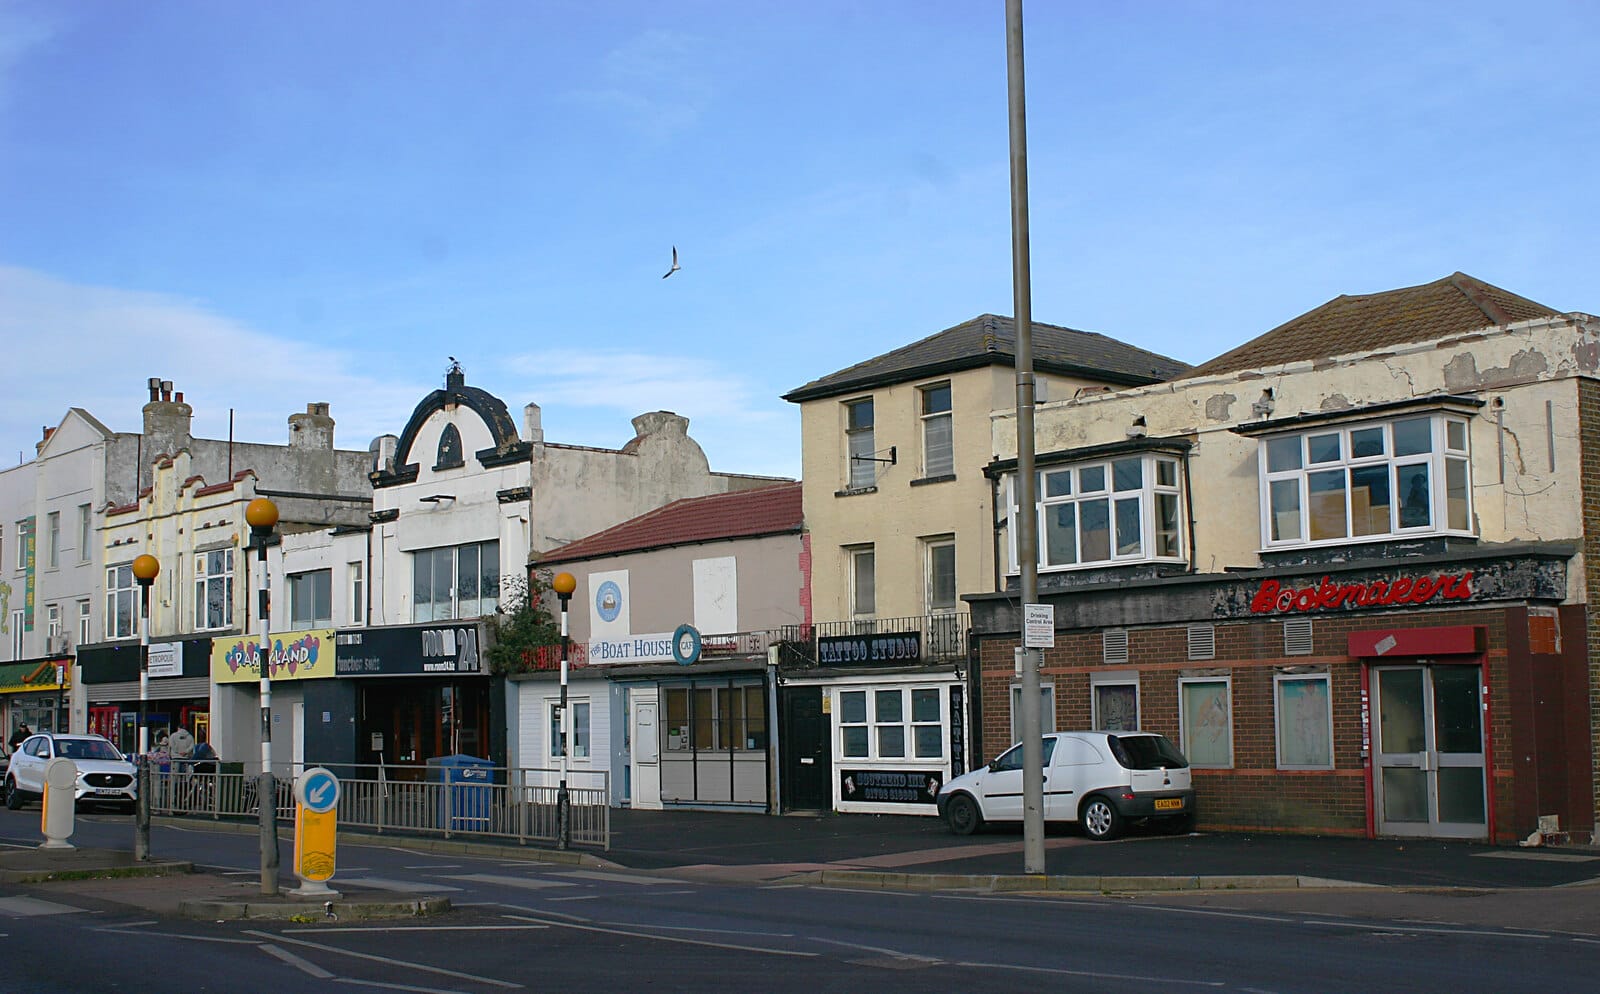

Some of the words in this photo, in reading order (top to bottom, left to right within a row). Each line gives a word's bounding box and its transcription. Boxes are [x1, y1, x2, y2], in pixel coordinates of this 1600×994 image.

[1250, 572, 1473, 612] Bookmakers
[235, 646, 310, 667] PARYLAND
[457, 628, 478, 671] 24
[601, 641, 631, 659] BOAT
[634, 639, 672, 657] HOUSE
[820, 640, 867, 662] TATTOO
[872, 637, 919, 660] STUDIO
